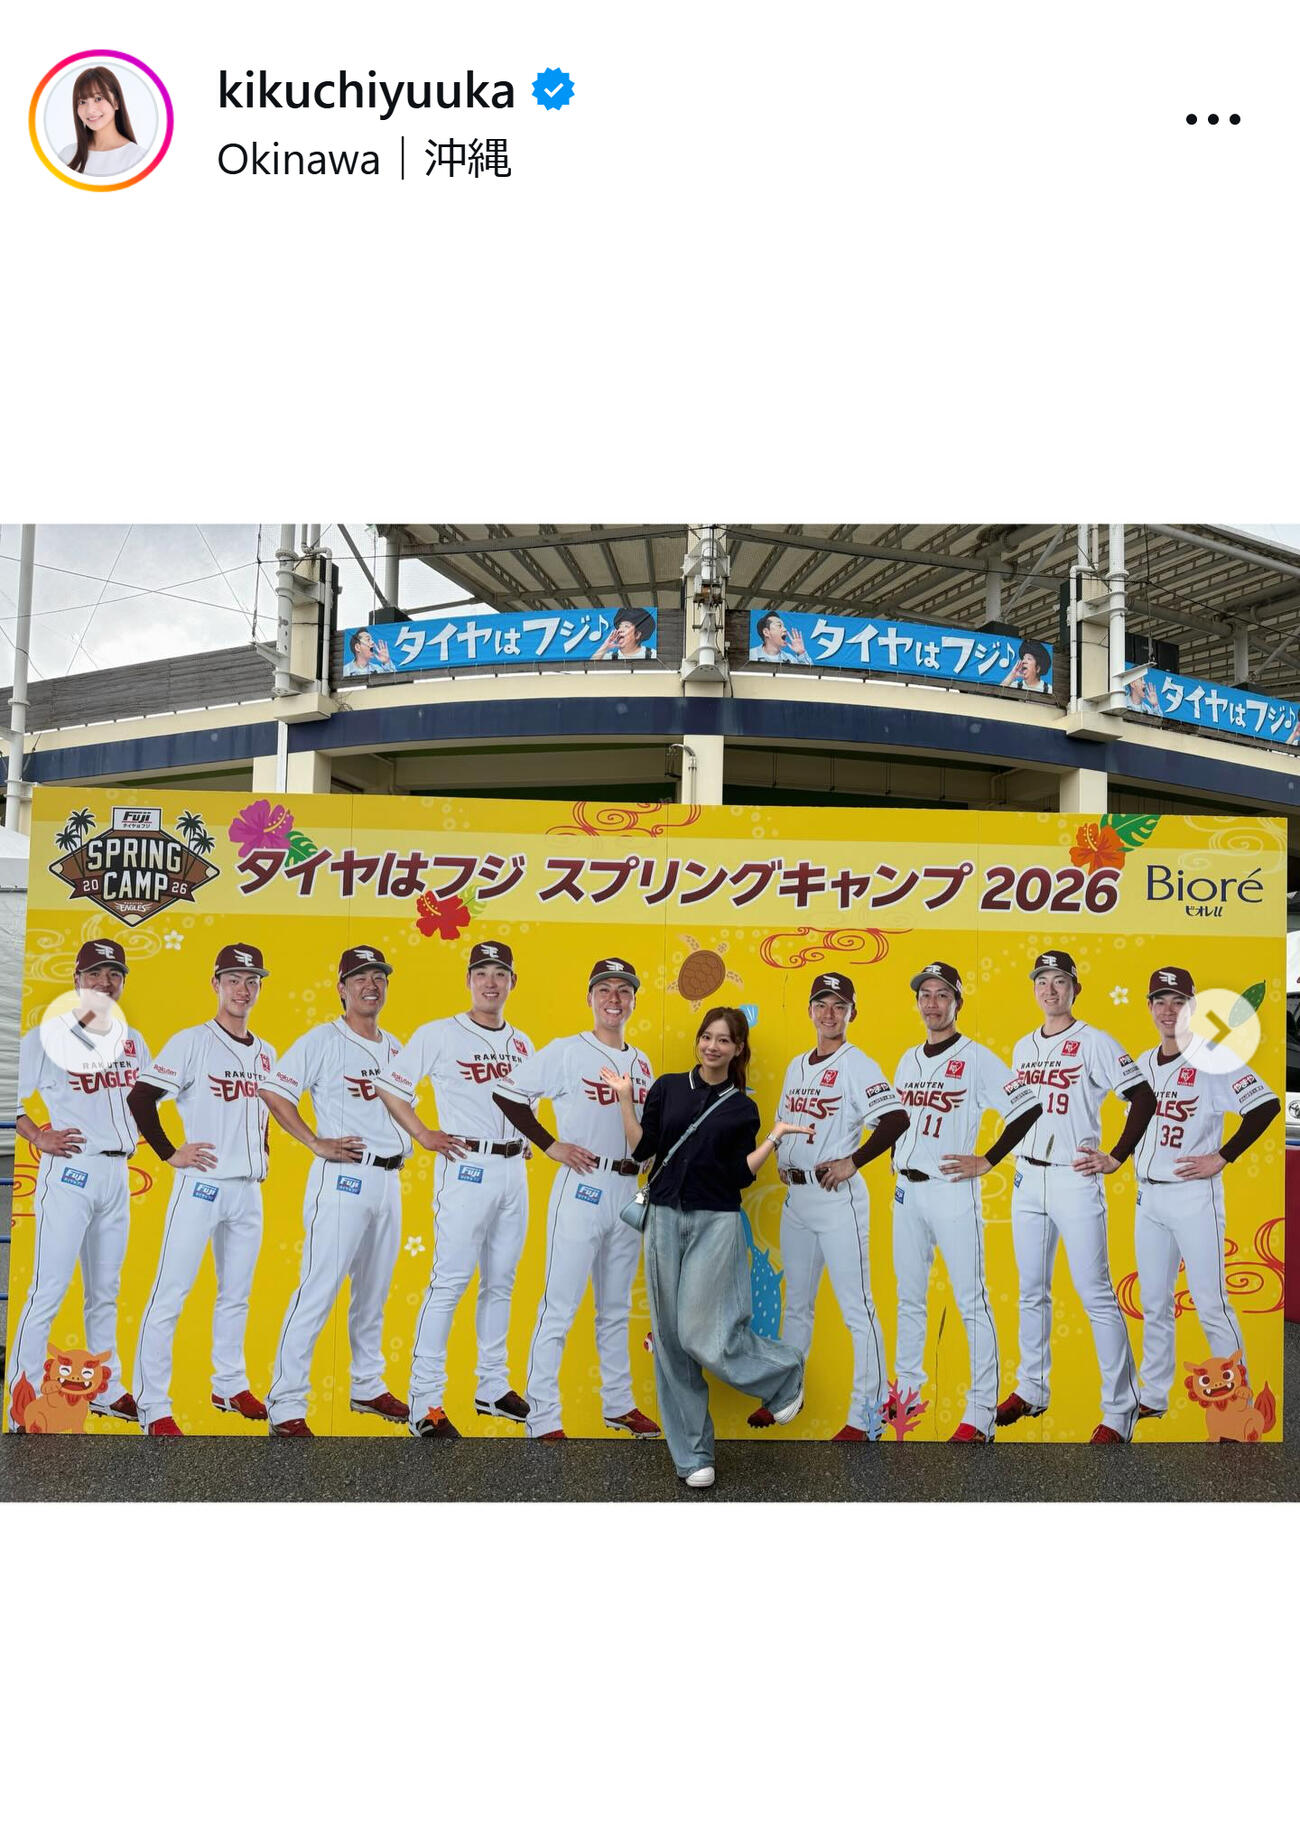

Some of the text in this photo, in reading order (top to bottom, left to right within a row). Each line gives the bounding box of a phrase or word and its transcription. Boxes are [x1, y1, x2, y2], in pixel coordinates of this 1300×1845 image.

[123, 811, 151, 823] Fuji
[87, 838, 182, 873] SPRING
[82, 879, 99, 891] 20
[103, 870, 169, 901] CAMP
[171, 881, 188, 894] 26
[236, 849, 1121, 914] タイヤはフジ スプリングキャンプ 2026
[1147, 864, 1263, 903] Bioré
[1047, 1092, 1069, 1115] 19
[922, 1114, 942, 1138] 11
[1160, 1125, 1184, 1149] 32
